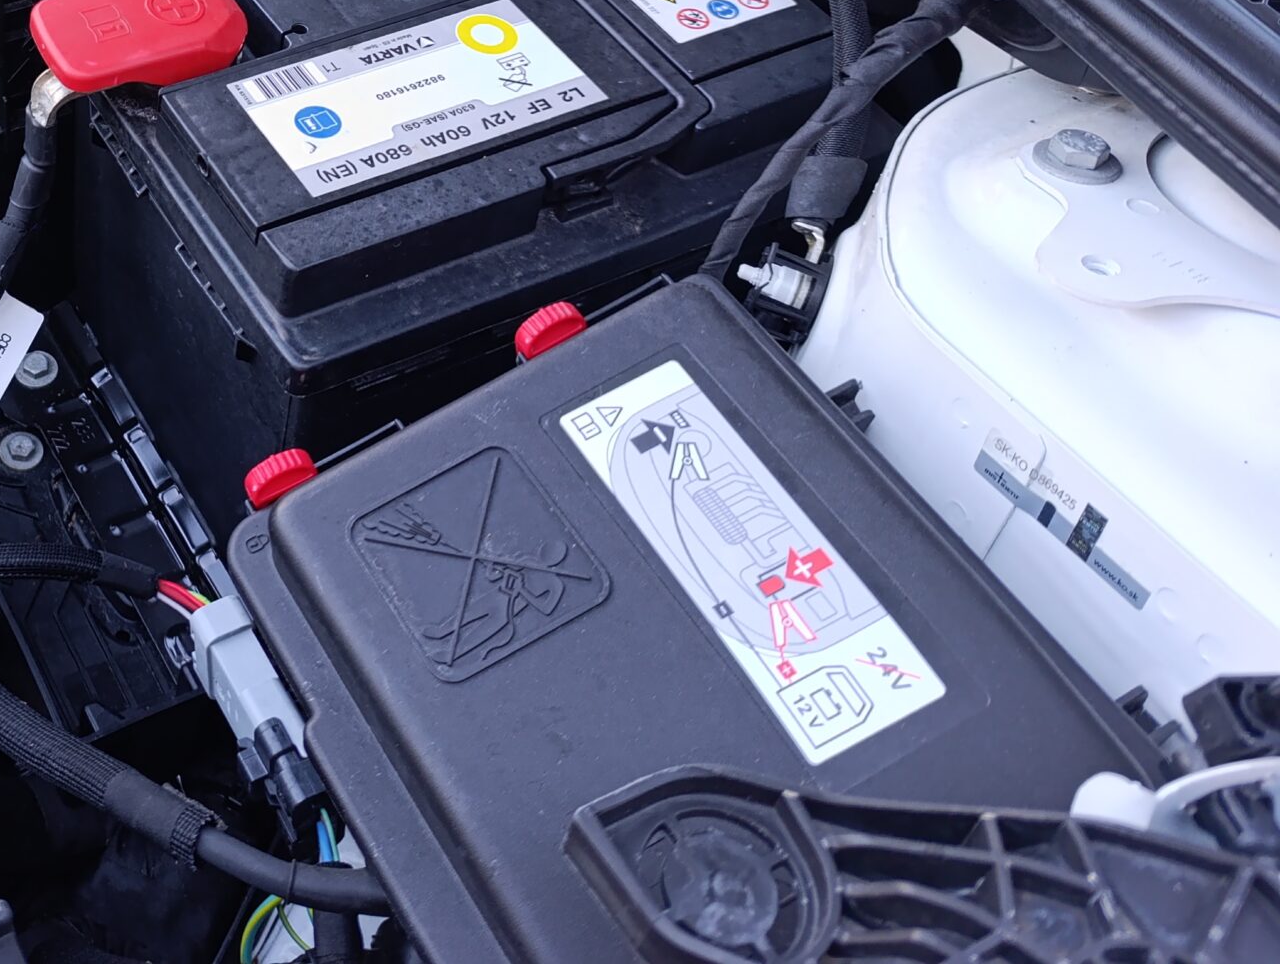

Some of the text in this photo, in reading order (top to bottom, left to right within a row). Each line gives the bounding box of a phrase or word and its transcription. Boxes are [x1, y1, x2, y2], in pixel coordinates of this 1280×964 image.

[322, 61, 341, 73] T1
[358, 43, 418, 65] VARTA
[376, 74, 446, 101] 9822616180
[401, 103, 476, 132] 630A (SAE-GS)
[316, 87, 586, 184] L2 EF 12V 60Ah 680A (EN)
[994, 438, 1028, 472] SK-KO
[1094, 558, 1139, 602] www.ko.sk
